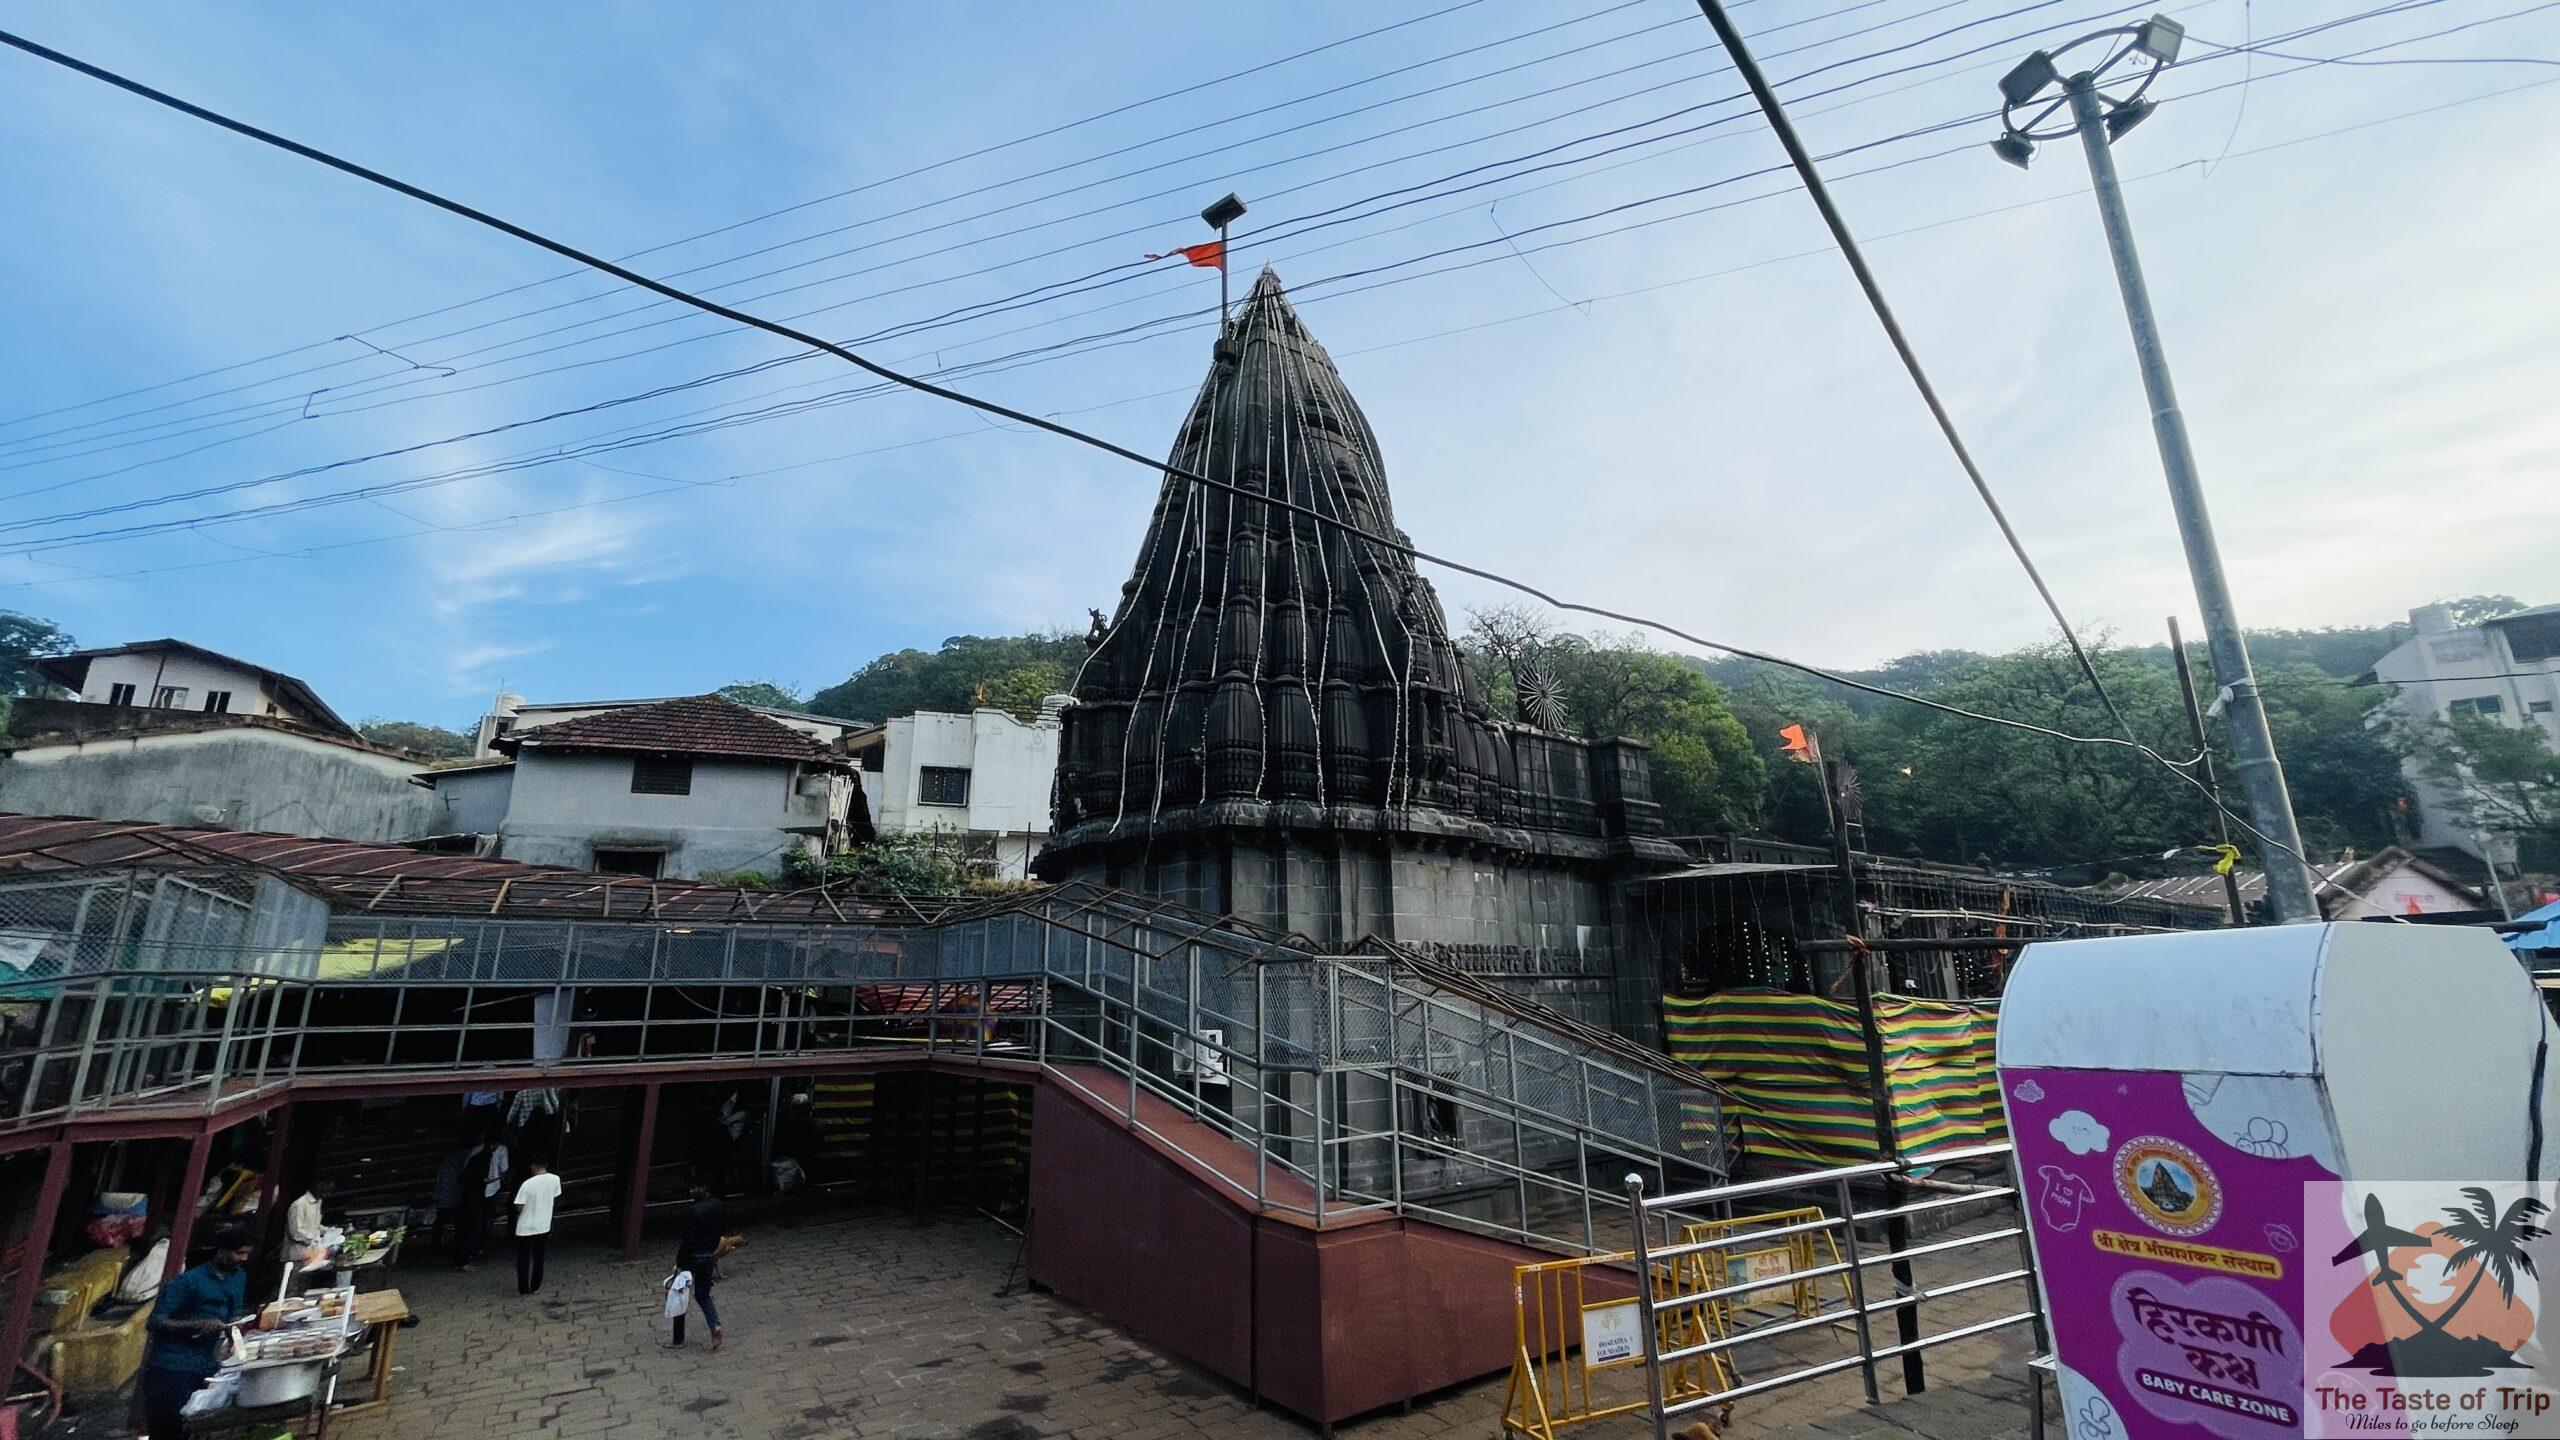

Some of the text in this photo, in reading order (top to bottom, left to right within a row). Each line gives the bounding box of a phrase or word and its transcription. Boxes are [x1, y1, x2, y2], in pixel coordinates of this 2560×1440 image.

[2051, 1192, 2071, 1207] MOM
[2097, 1232, 2113, 1248] श्री
[2126, 1287, 2287, 1358] हिरकणी
[2178, 1343, 2260, 1390] कक्ष
[2142, 1373, 2291, 1422] BABY CARE ZONE
